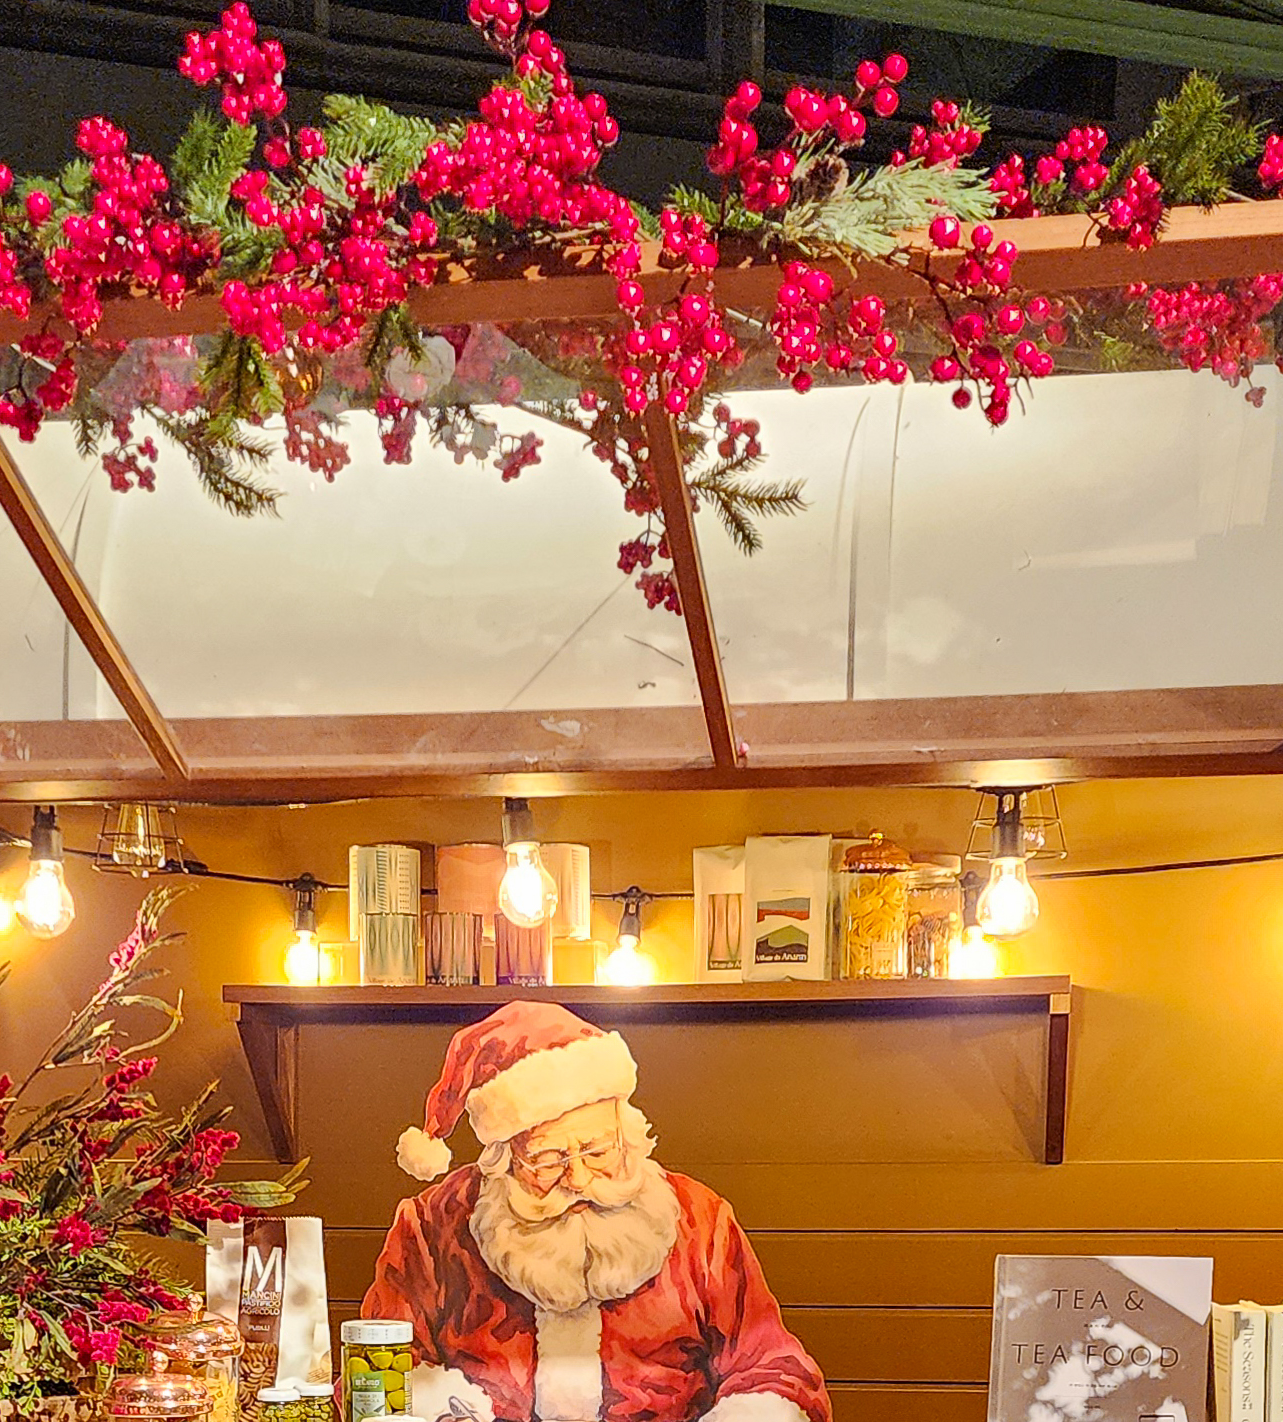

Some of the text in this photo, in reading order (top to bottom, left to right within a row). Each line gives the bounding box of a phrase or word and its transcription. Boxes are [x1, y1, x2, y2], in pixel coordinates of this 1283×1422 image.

[1052, 1289, 1144, 1311] TEA &
[1011, 1343, 1179, 1368] TEA FOOD
